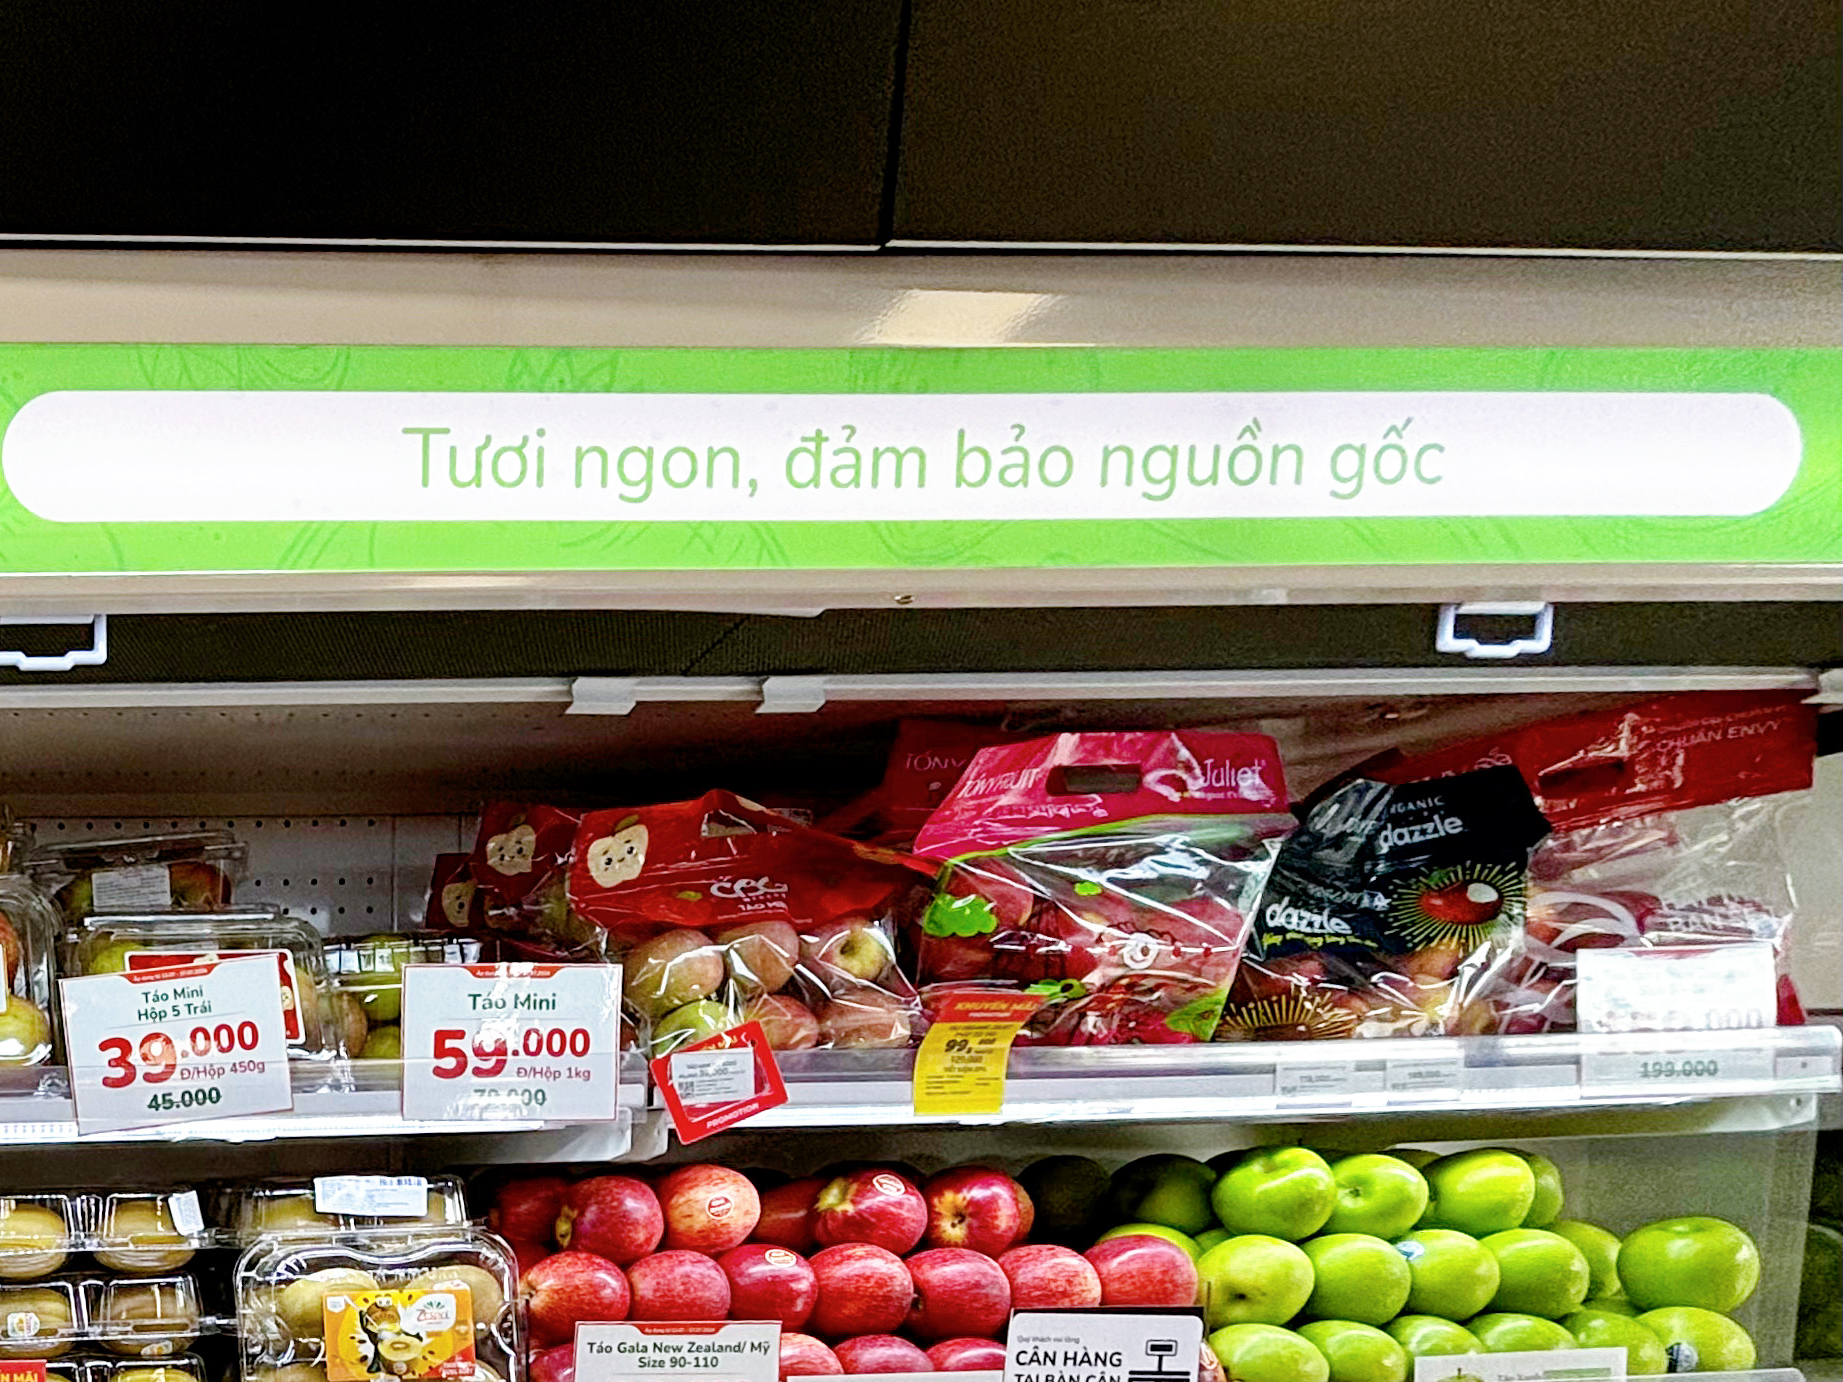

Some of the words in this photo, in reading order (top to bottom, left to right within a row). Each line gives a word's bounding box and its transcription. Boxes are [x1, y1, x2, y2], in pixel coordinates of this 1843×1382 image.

[403, 425, 551, 492] Tươi
[574, 440, 758, 503] ngon,
[786, 424, 934, 492] đảm
[955, 424, 1077, 491] bảo
[1101, 414, 1308, 502] nguồn
[1331, 418, 1445, 500] gốc
[1379, 814, 1462, 852] dazzle
[1265, 898, 1352, 936] dazzle
[141, 990, 169, 1004] Táo
[173, 986, 204, 1001] Mini
[468, 991, 507, 1010] Táo
[514, 992, 557, 1010] Mini
[137, 1008, 167, 1023] Hộp
[172, 1004, 181, 1017] 5
[185, 1001, 212, 1014] Trái
[180, 1064, 225, 1081] Đ/Hộp
[230, 1059, 266, 1074] 450g
[516, 1067, 562, 1081] Đ/Hộp
[566, 1066, 591, 1081] 1kg
[147, 1087, 222, 1111] 45.000
[415, 1306, 451, 1324] Zespri
[587, 1341, 613, 1354] Táo
[617, 1342, 649, 1354] Gala
[653, 1342, 683, 1353] New
[687, 1341, 747, 1354] Zealand/
[750, 1341, 771, 1355] Mỹ
[1016, 1346, 1057, 1367] CÂN
[1063, 1346, 1122, 1367] HÀNG
[638, 1356, 666, 1368] Size
[669, 1356, 719, 1368] 90-110
[13, 1371, 38, 1382] MÃI
